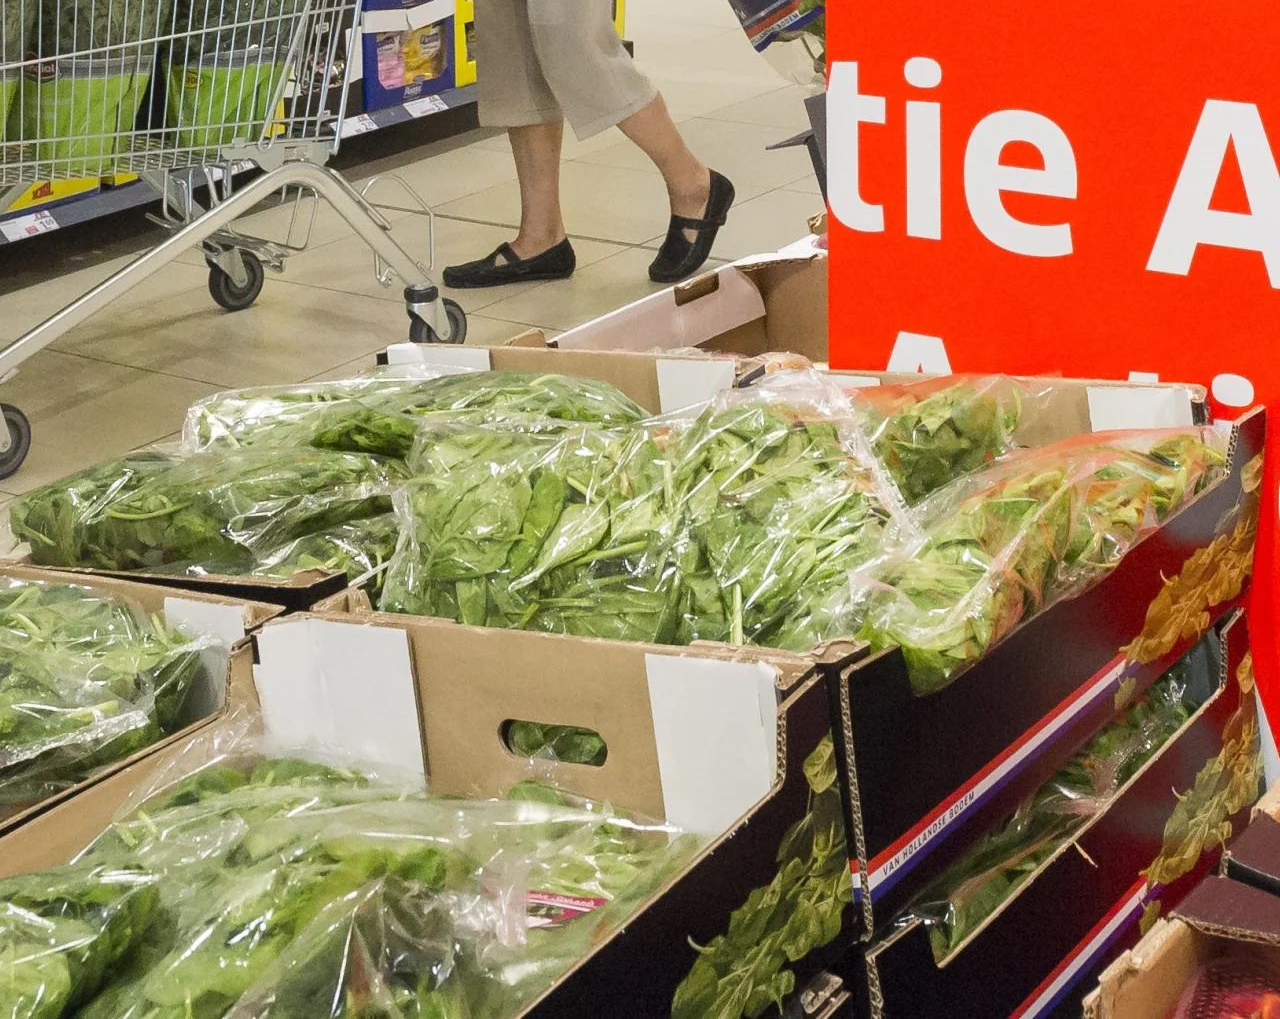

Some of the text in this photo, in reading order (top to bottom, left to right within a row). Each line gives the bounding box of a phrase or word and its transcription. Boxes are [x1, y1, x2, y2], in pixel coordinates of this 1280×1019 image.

[828, 57, 1080, 258] tie
[882, 791, 975, 876] VAN HOLLANDSE BODEM
